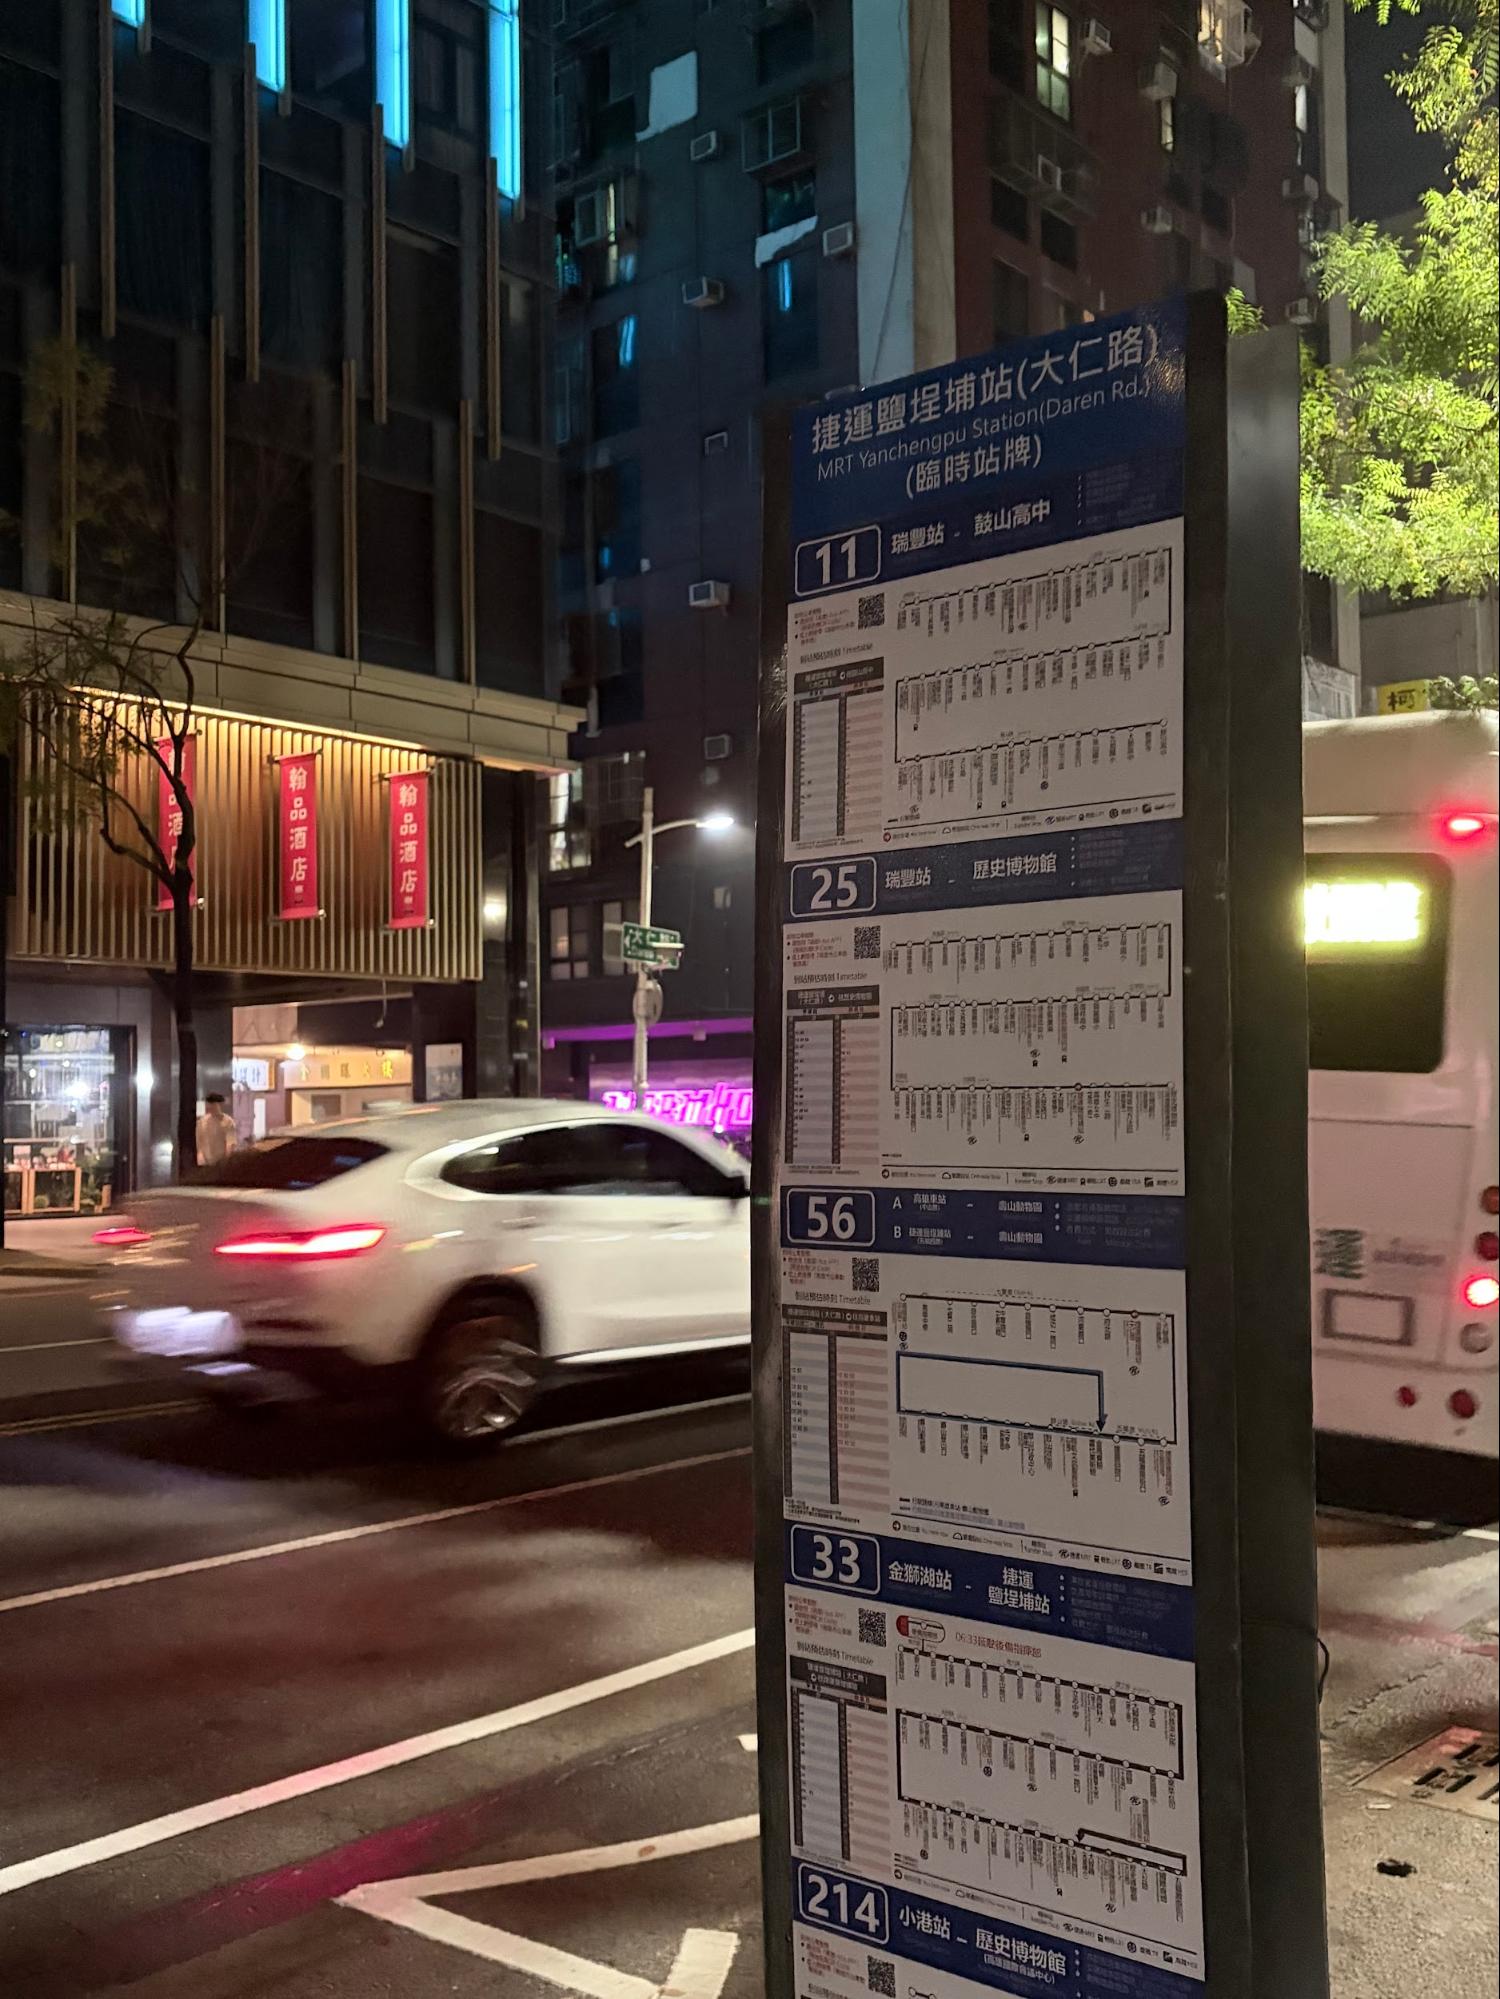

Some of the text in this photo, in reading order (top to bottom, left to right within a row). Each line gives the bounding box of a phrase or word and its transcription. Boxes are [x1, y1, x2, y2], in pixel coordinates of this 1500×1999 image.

[812, 326, 1159, 454] 捷運鹽埕埔站(大仁路)
[818, 374, 1152, 481] MRT Yanchengpu Station(Daren Rd.)
[906, 434, 1043, 499] (臨時站牌)
[891, 522, 945, 554] 瑞豐站
[974, 499, 1051, 537] 鼓山高中
[815, 535, 857, 585] 11
[289, 766, 308, 883] 翰品酒店
[399, 783, 418, 894] 翰品酒店
[810, 865, 859, 911] 25
[885, 866, 931, 889] 瑞豐站
[972, 852, 1057, 881] 歷史博物館
[807, 1196, 856, 1239] 56
[892, 1196, 902, 1209] A
[893, 1225, 902, 1239] B
[812, 1535, 860, 1583] 33
[888, 1560, 952, 1592] 金獅湖站
[1002, 1566, 1034, 1590] 捷運
[988, 1588, 1050, 1616] 鹽埕埔站
[807, 1874, 879, 1933] 214
[899, 1904, 951, 1941] 小港站
[976, 1927, 1067, 1977] 歷史博物館
